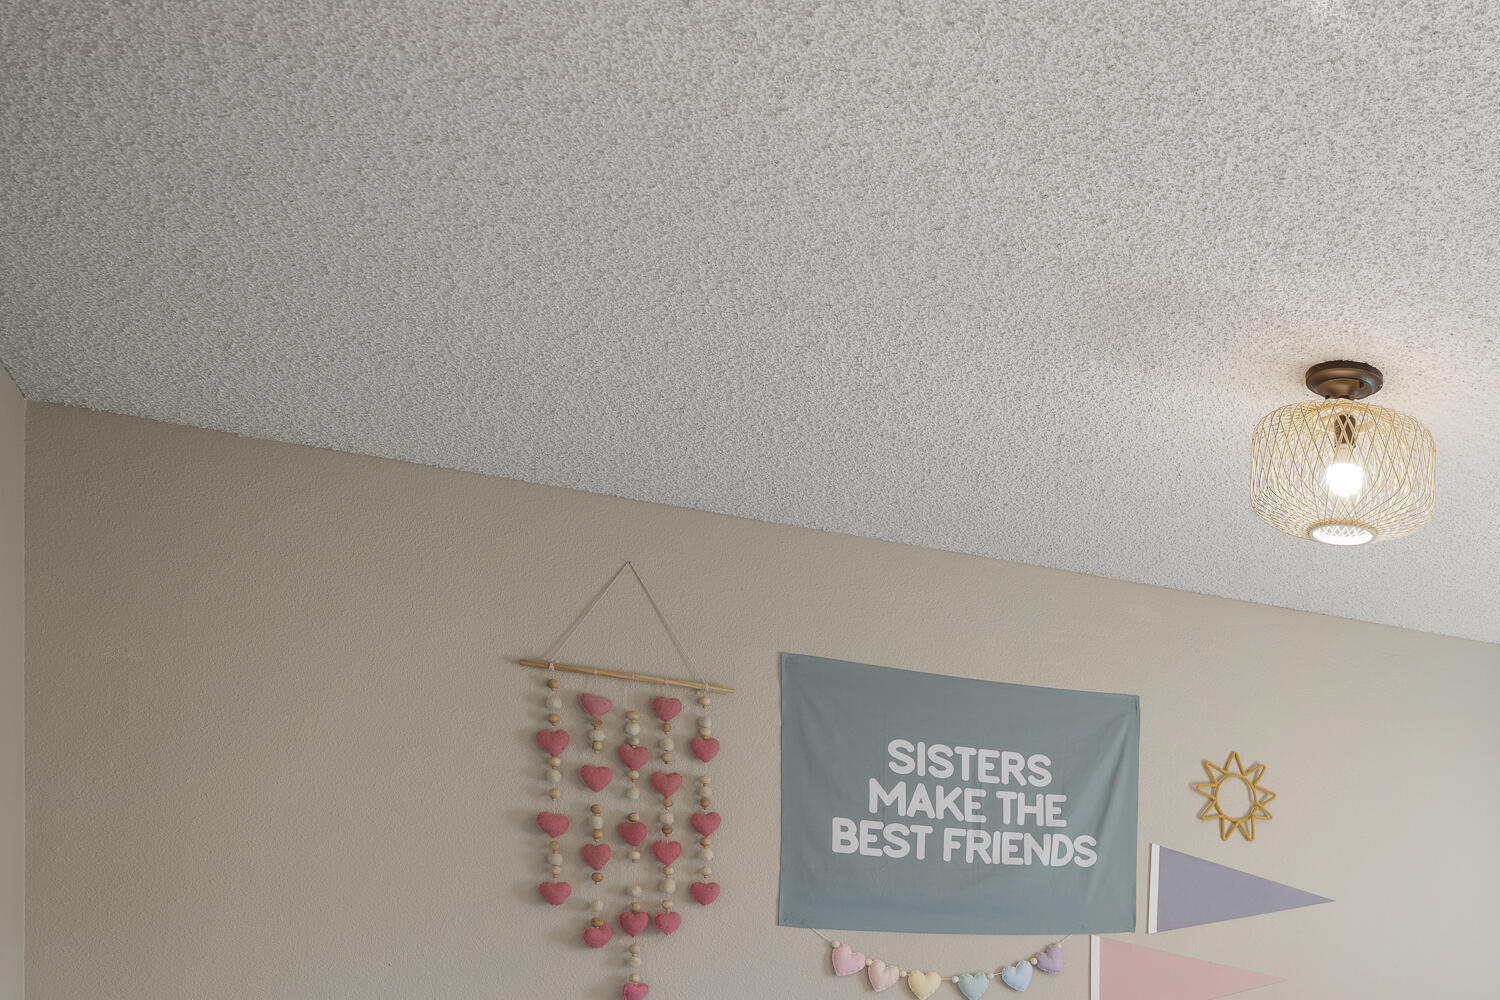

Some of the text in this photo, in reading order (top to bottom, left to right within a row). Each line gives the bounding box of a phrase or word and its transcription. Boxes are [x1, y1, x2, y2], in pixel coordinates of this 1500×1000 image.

[887, 738, 1052, 788] SISTERS
[868, 778, 1067, 828] MAKE THE
[832, 817, 1098, 868] BEST FRIENDS
